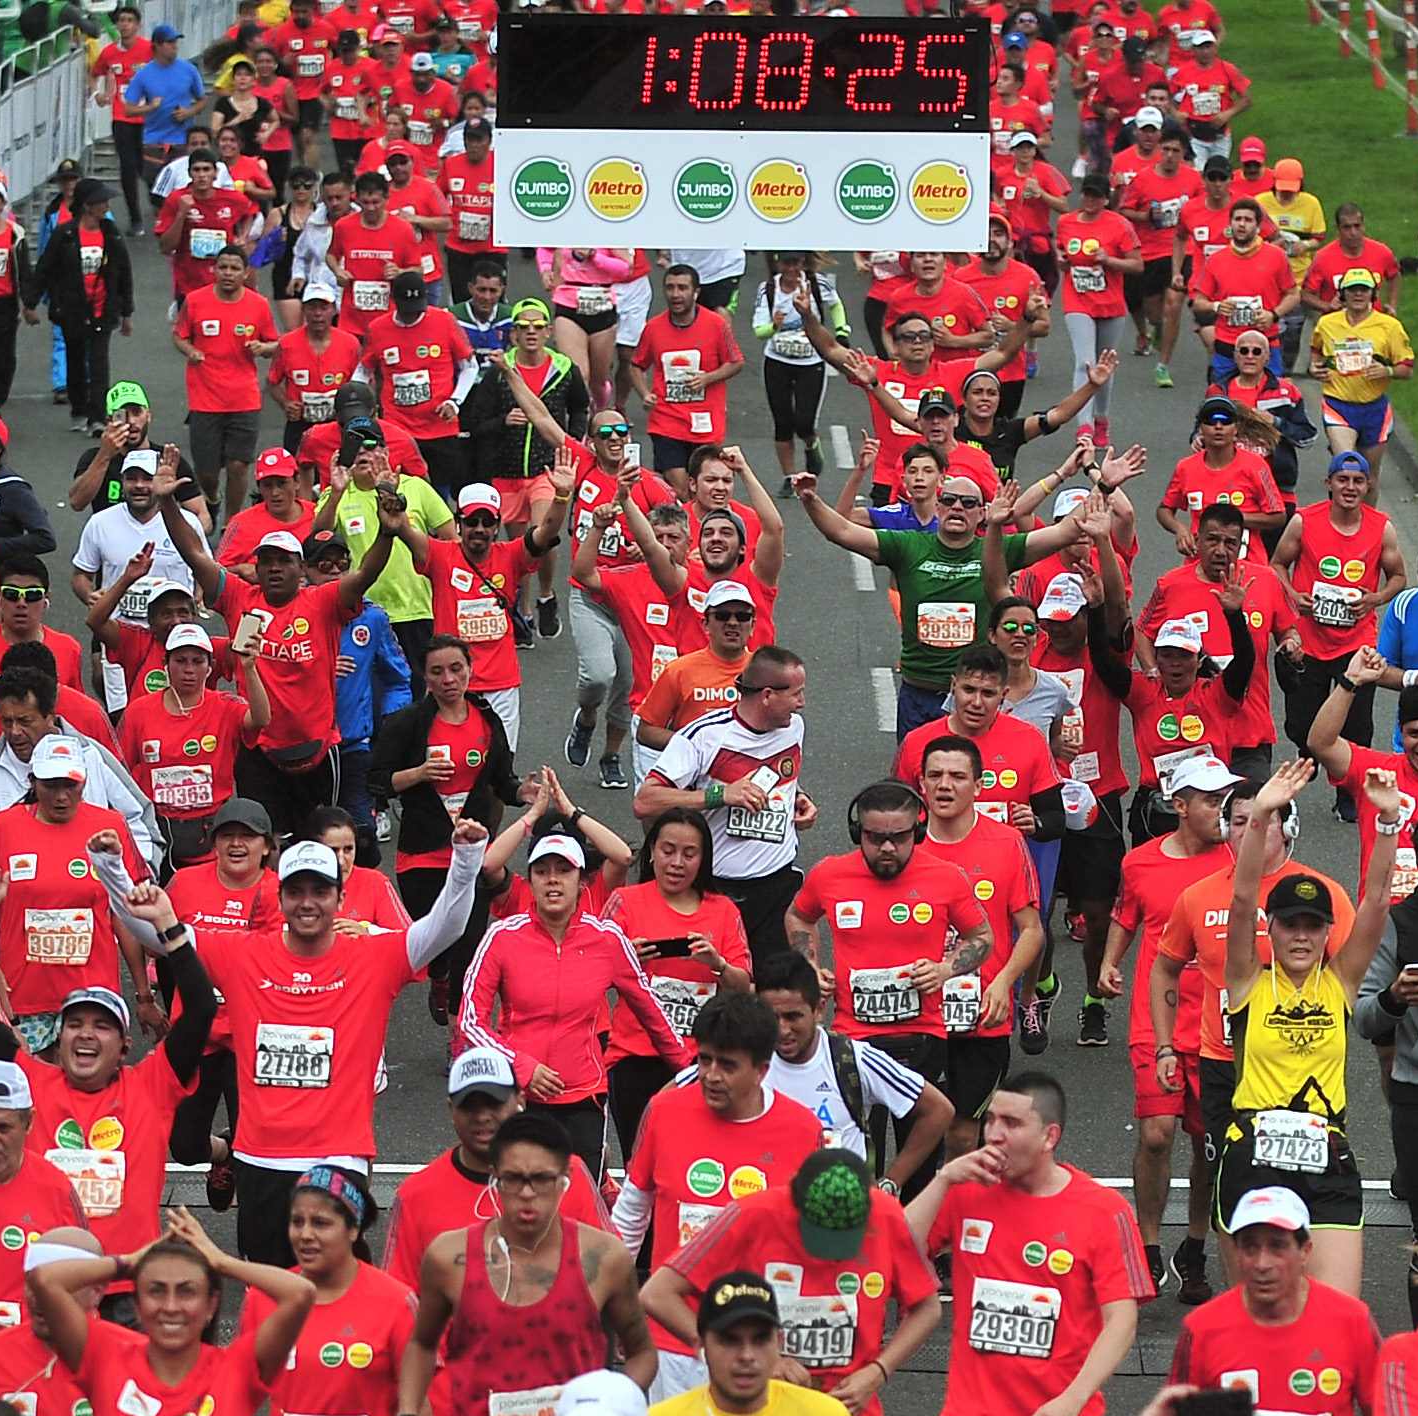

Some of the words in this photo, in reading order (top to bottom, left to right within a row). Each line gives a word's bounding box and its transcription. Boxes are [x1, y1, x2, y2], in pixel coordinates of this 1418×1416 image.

[515, 180, 569, 196] JUMBO
[588, 179, 643, 196] Metro
[678, 182, 732, 197] JUMBO
[751, 181, 806, 198] Metro
[840, 183, 894, 199] JUMBO
[913, 182, 968, 200] Metro
[458, 616, 508, 636] 39693
[918, 619, 975, 643] 39339
[268, 639, 314, 659] TAPE
[727, 807, 787, 832] 30922
[203, 915, 250, 927] BODYT
[27, 932, 91, 954] 39786
[855, 990, 920, 1018] 24474
[256, 1028, 306, 1042] porvenir
[258, 1051, 325, 1078] 27788
[91, 1126, 122, 1145] Metro
[1259, 1136, 1325, 1164] 27423
[690, 1171, 723, 1184] JUMBO
[731, 1178, 763, 1192] Metro
[734, 1284, 772, 1303] efecty
[777, 1301, 823, 1314] orvenir
[971, 1309, 1051, 1347] 29390
